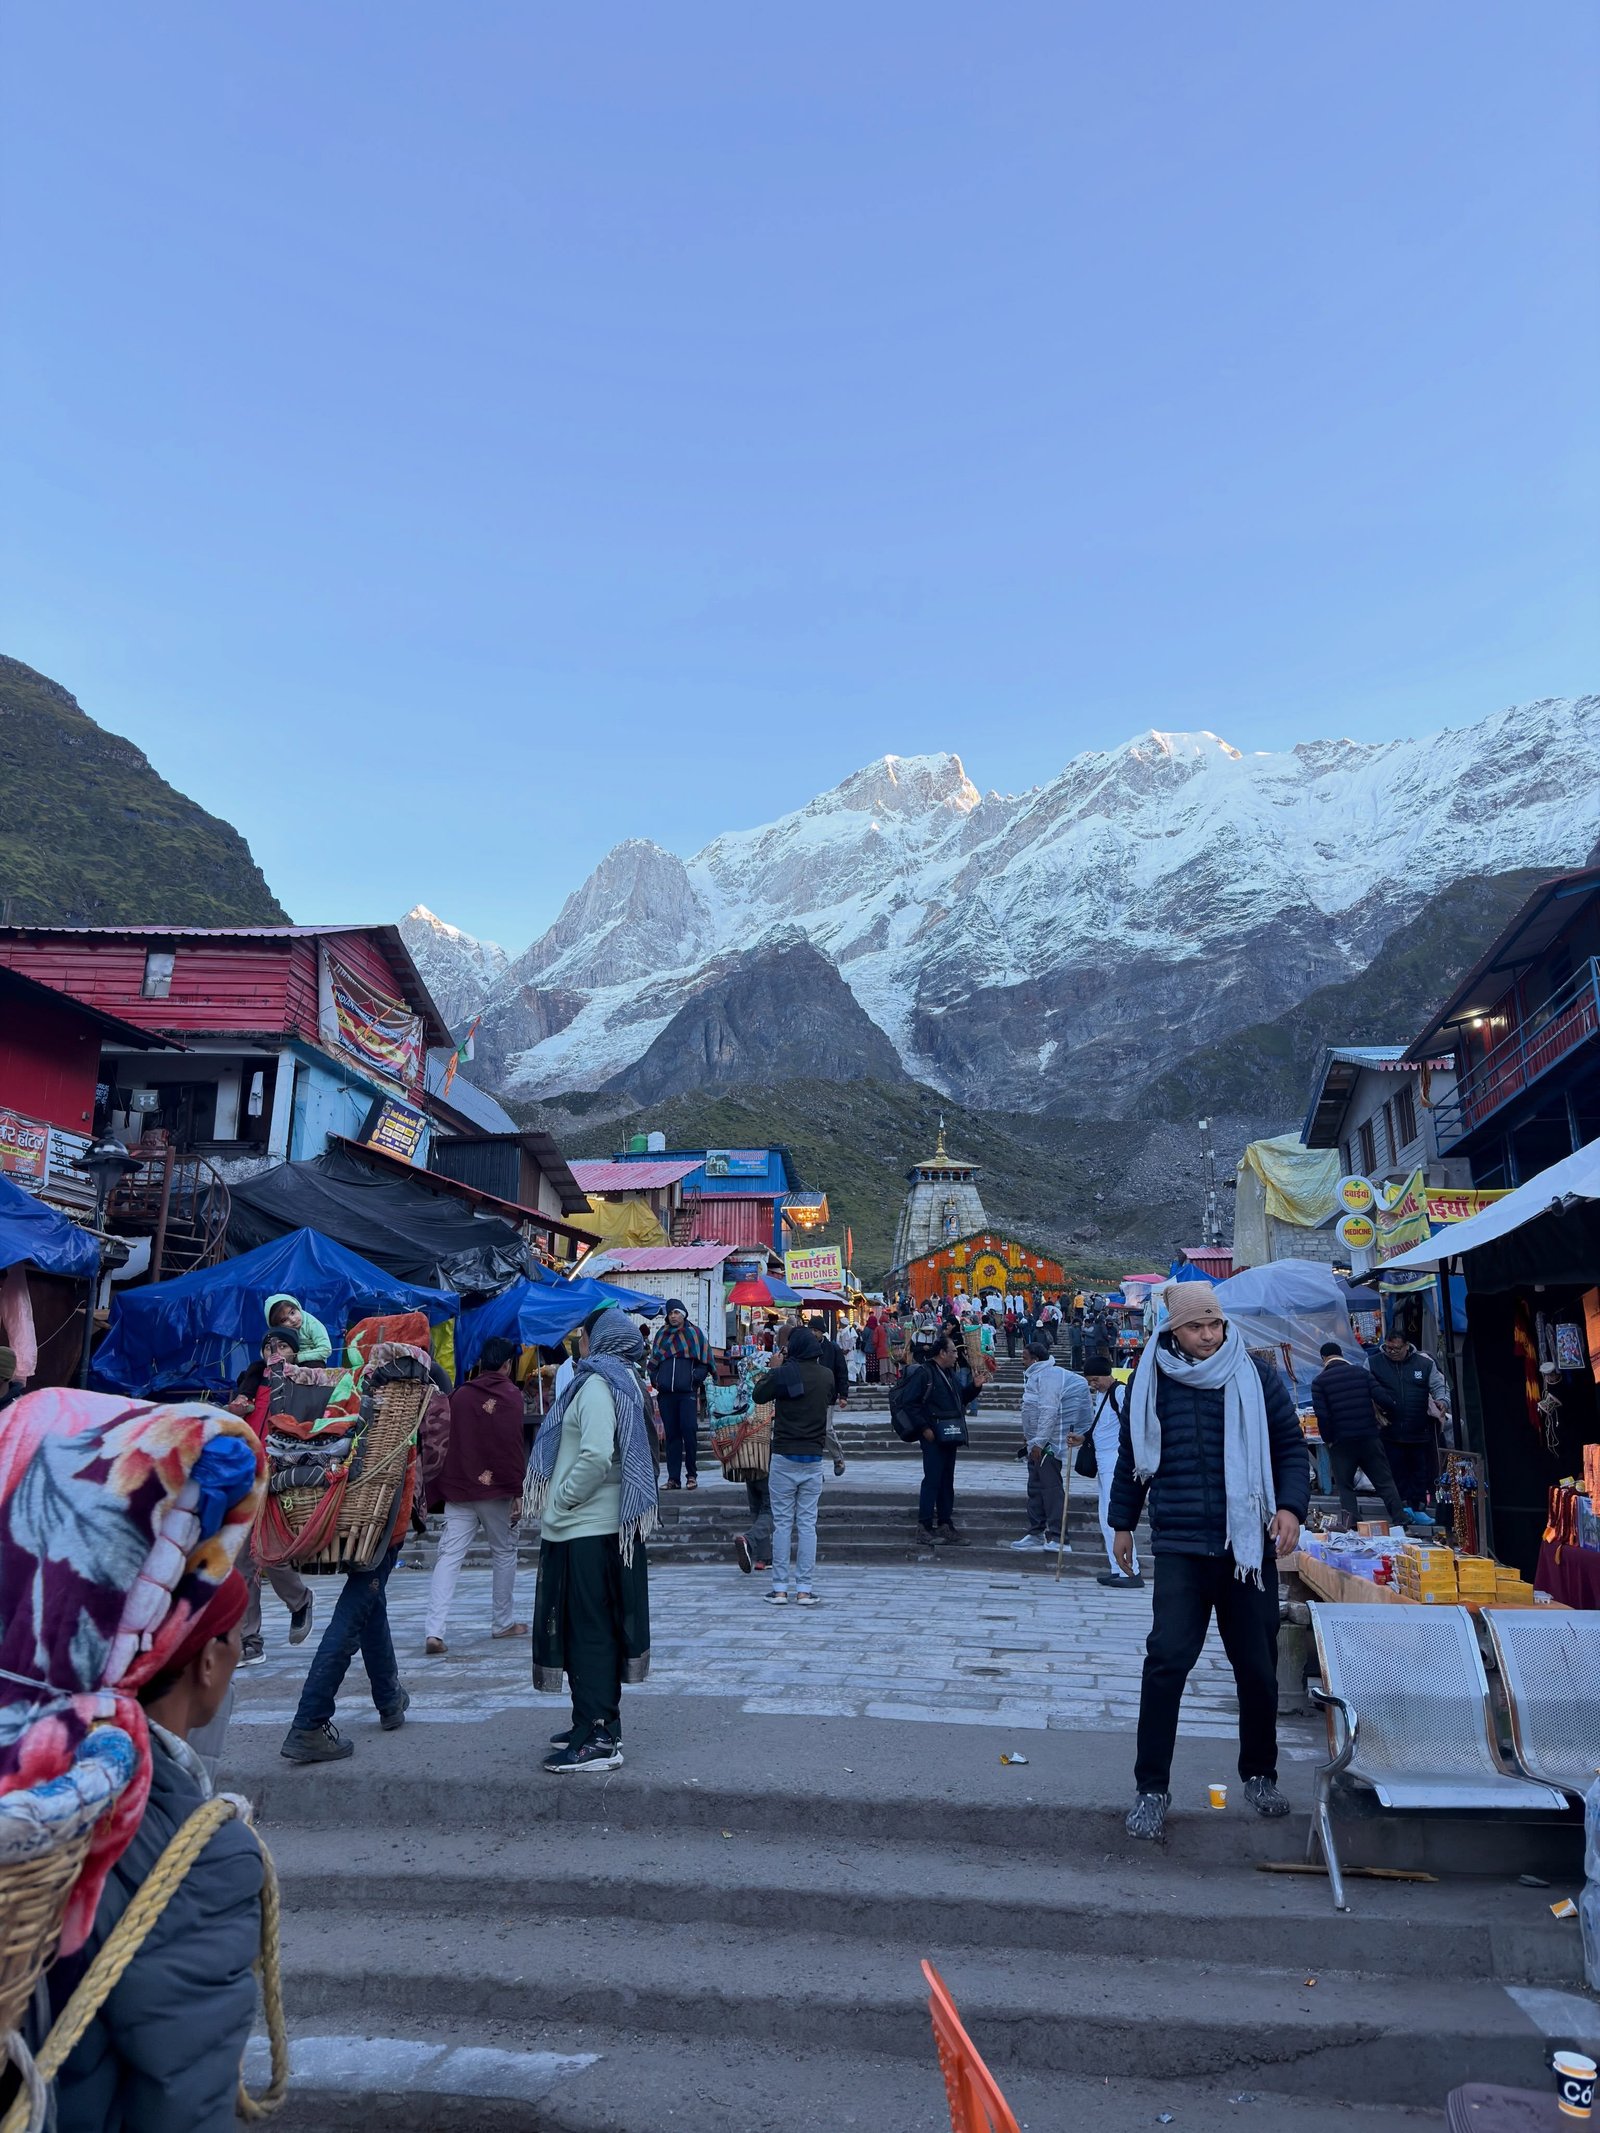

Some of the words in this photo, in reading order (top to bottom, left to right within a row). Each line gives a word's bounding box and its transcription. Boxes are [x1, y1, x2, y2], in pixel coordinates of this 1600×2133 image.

[18, 1129, 46, 1150] होटल
[1427, 1195, 1471, 1219] ाईयाँ
[1344, 1228, 1372, 1236] MEDICINE
[791, 1268, 839, 1281] MEDICINES
[1564, 2081, 1596, 2105] Có
